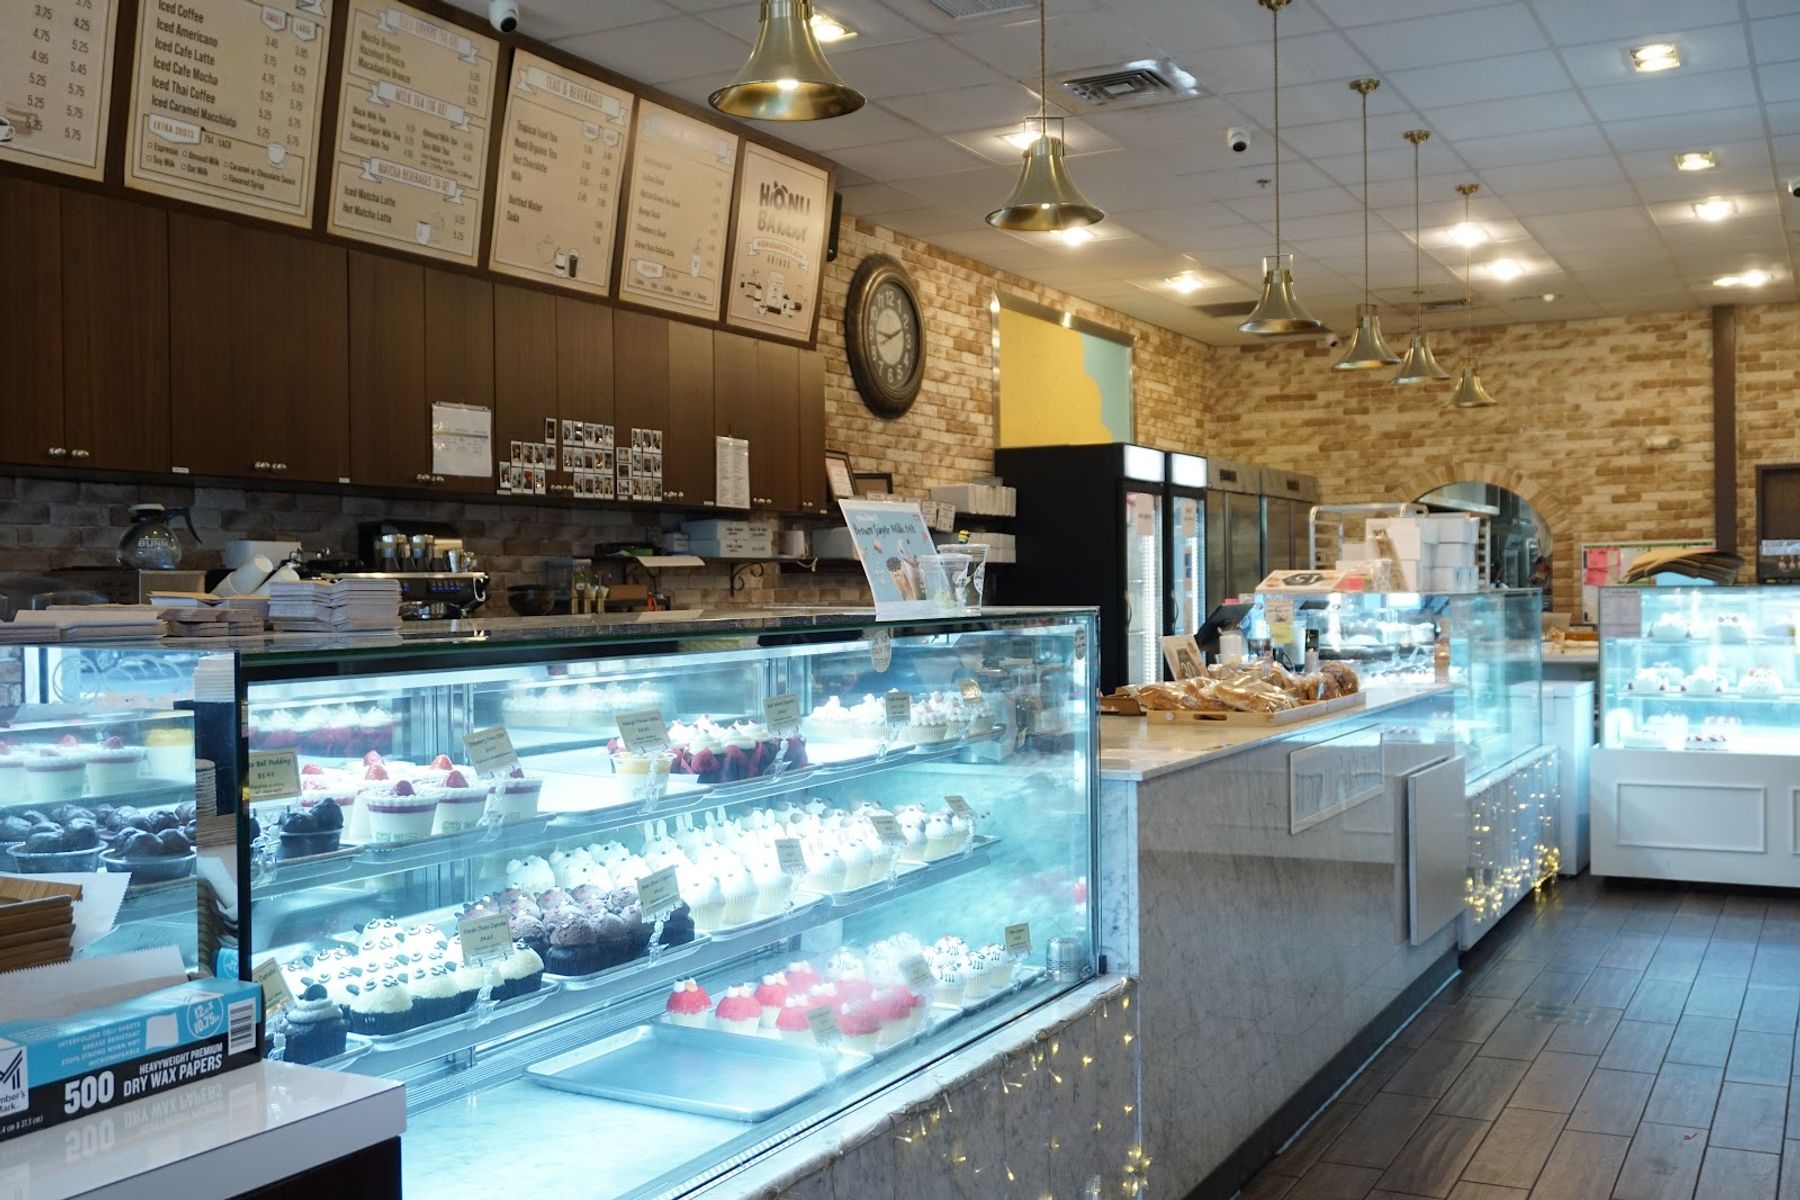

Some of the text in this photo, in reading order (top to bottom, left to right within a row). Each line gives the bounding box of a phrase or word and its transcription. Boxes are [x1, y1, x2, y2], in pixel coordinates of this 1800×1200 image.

[35, 5, 90, 31] 3.75 4.25
[158, 0, 204, 23] Iced Coffee
[33, 28, 88, 53] 4.75 5.25
[157, 18, 218, 48] Iced Americano
[155, 37, 215, 66] Iced Cafe Latte
[31, 50, 87, 76] 4.95 5.45
[154, 56, 218, 86] Iced Cafe Mocha
[29, 72, 85, 97] 5.25 5.75
[152, 76, 216, 104] Iced Thai Coffee
[28, 94, 83, 119] 5.25 5.75
[152, 95, 237, 128] Iced Caramel Macchiato
[65, 128, 81, 141] 5.75
[154, 120, 173, 133] EXTRA
[344, 186, 396, 208] Iced Matcha Latte
[342, 202, 392, 224] Hot Matcha Latte
[877, 293, 885, 309] 11
[886, 290, 895, 307] 12
[898, 298, 902, 313] 1
[870, 306, 878, 321] 10
[904, 314, 909, 329] 2
[906, 334, 912, 349] 3
[871, 345, 877, 361] 8
[904, 352, 909, 367] 4
[878, 361, 884, 376] 7
[888, 368, 894, 384] 6
[897, 364, 903, 380] 5
[58, 1032, 102, 1048] INTERFOLDED
[102, 1028, 116, 1038] DELI
[118, 1022, 141, 1032] SHEETS
[82, 1031, 140, 1050] GREASE RESISTANT
[61, 1039, 141, 1066] STAYS STRONG WHEN WET
[140, 1042, 223, 1075] HEAVYWEIGHT PREMIUM
[124, 1054, 223, 1098] DRY WAX PAPERS
[64, 1070, 114, 1115] 500
